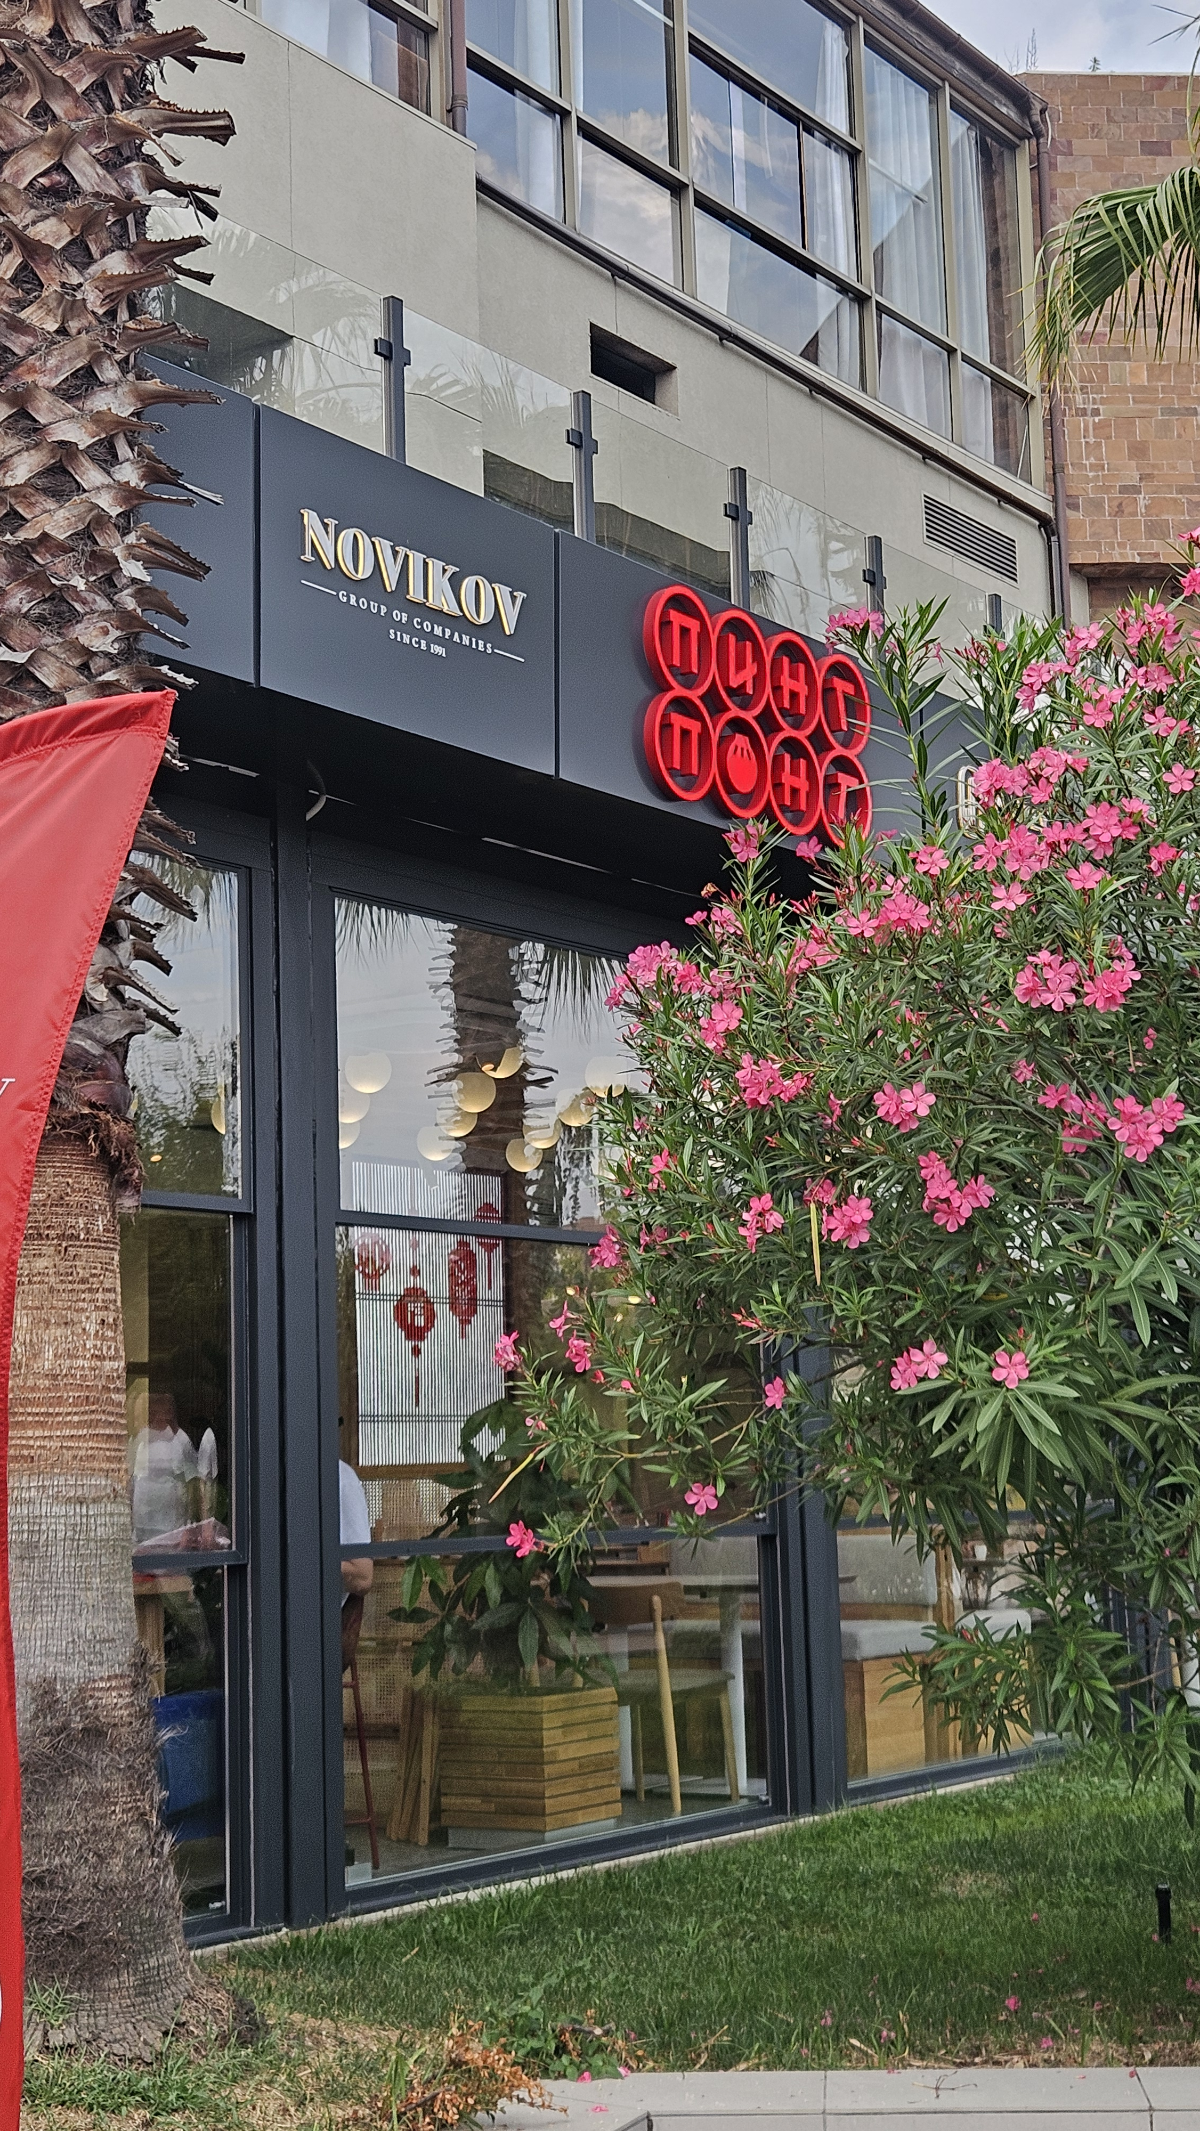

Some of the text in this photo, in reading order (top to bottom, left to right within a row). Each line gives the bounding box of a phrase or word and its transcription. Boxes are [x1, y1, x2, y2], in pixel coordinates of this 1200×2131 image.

[300, 508, 527, 636] NOVIKOV
[338, 590, 493, 654] GROUP OF COMPANIES
[389, 628, 447, 658] SINCE 1991
